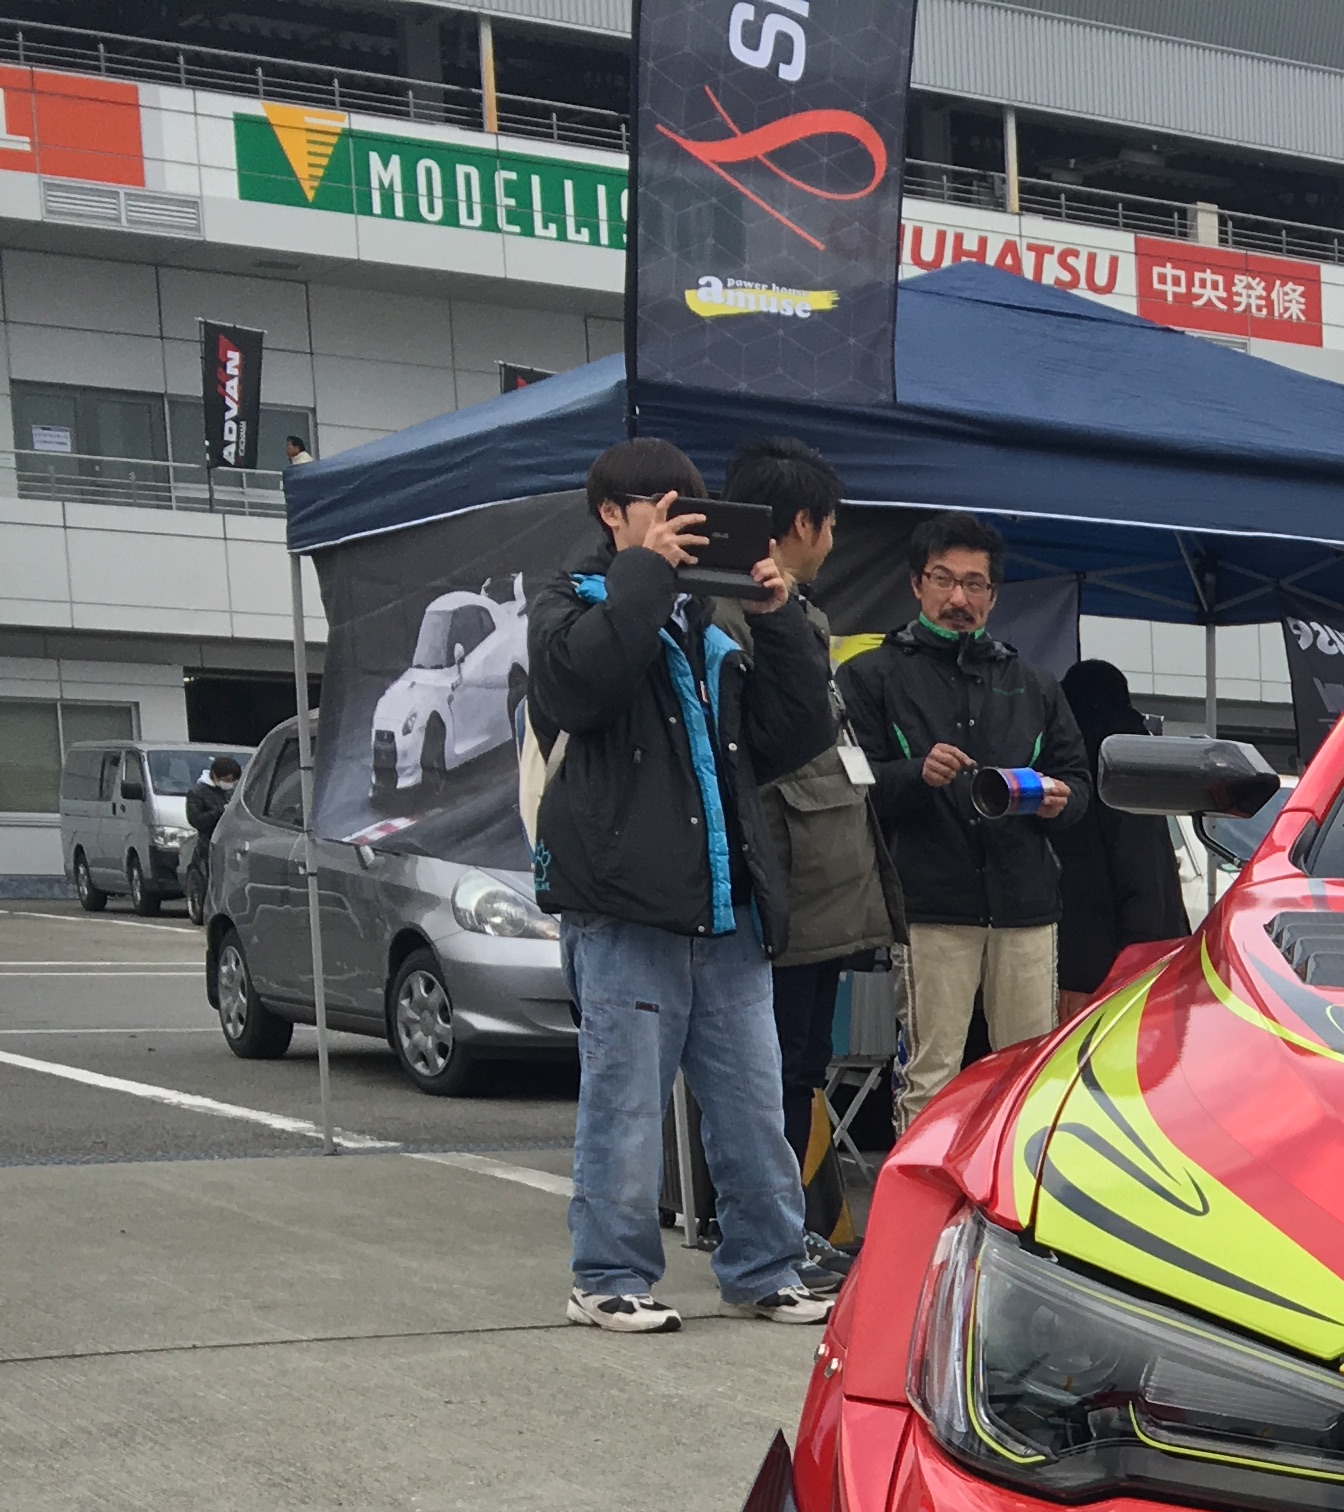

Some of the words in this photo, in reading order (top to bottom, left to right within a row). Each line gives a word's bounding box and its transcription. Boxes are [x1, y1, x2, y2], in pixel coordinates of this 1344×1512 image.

[697, 276, 811, 318] amuse
[727, 277, 768, 291] power
[1152, 261, 1308, 322] 中央発條
[223, 350, 240, 465] ADVAN
